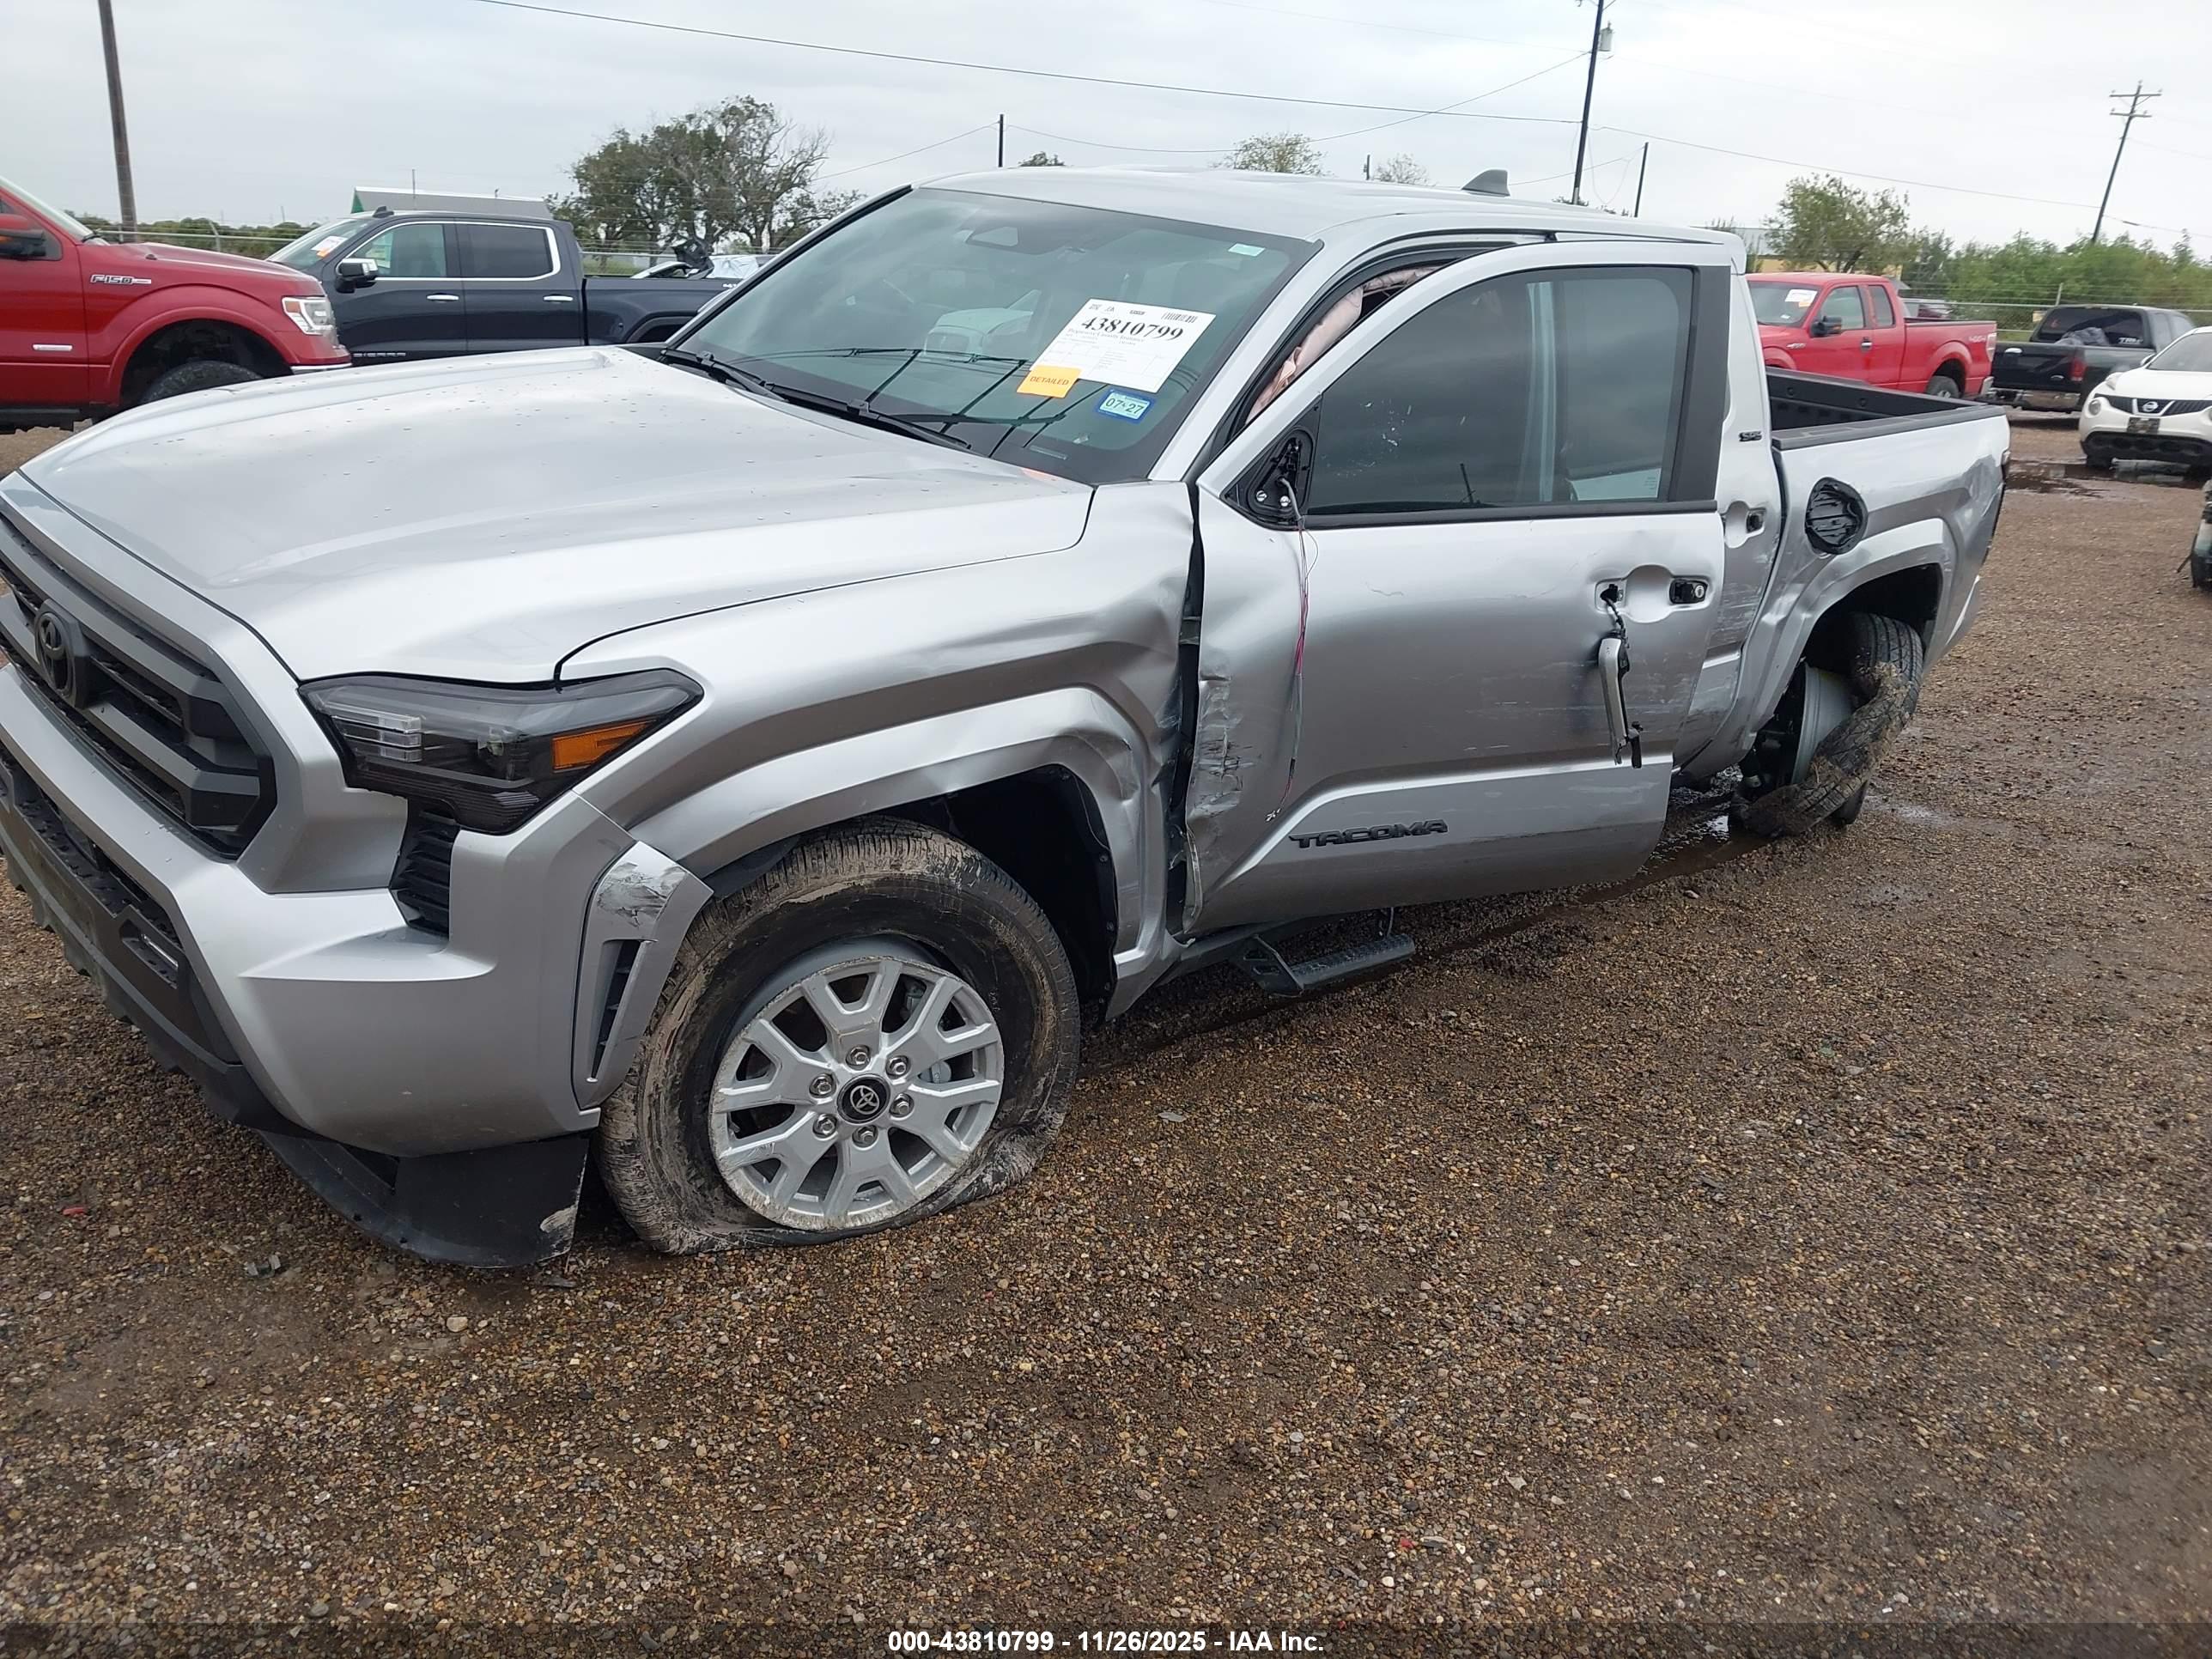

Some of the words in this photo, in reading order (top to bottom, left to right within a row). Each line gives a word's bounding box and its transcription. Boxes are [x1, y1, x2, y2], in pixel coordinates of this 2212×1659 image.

[1081, 316, 1184, 342] 43810799
[1030, 376, 1070, 386] DETAILED
[1105, 398, 1124, 409] 07
[1125, 403, 1145, 414] 27
[1289, 819, 1449, 849] TACOMA
